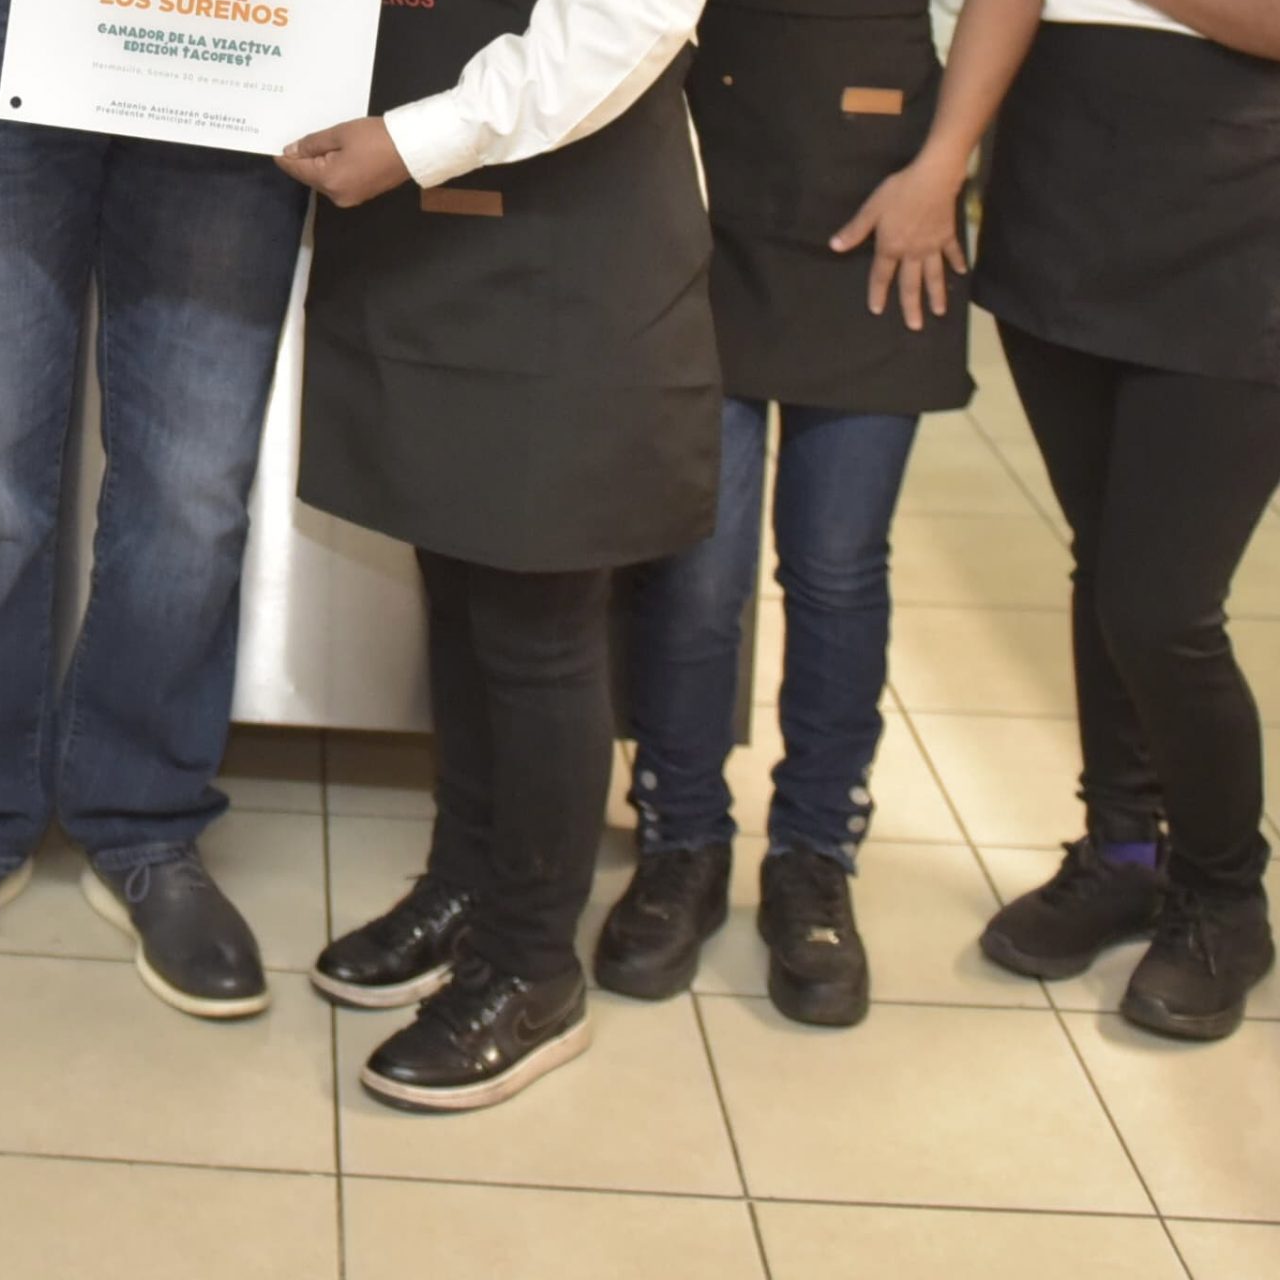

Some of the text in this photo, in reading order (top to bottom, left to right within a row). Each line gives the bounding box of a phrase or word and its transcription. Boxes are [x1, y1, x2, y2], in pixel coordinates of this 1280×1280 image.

[97, 23, 282, 57] GANADOR DE LA VIACTIVA
[123, 40, 252, 67] EDICIÓN TACOFEST
[96, 105, 144, 118] Presidente
[110, 100, 147, 111] Antonio
